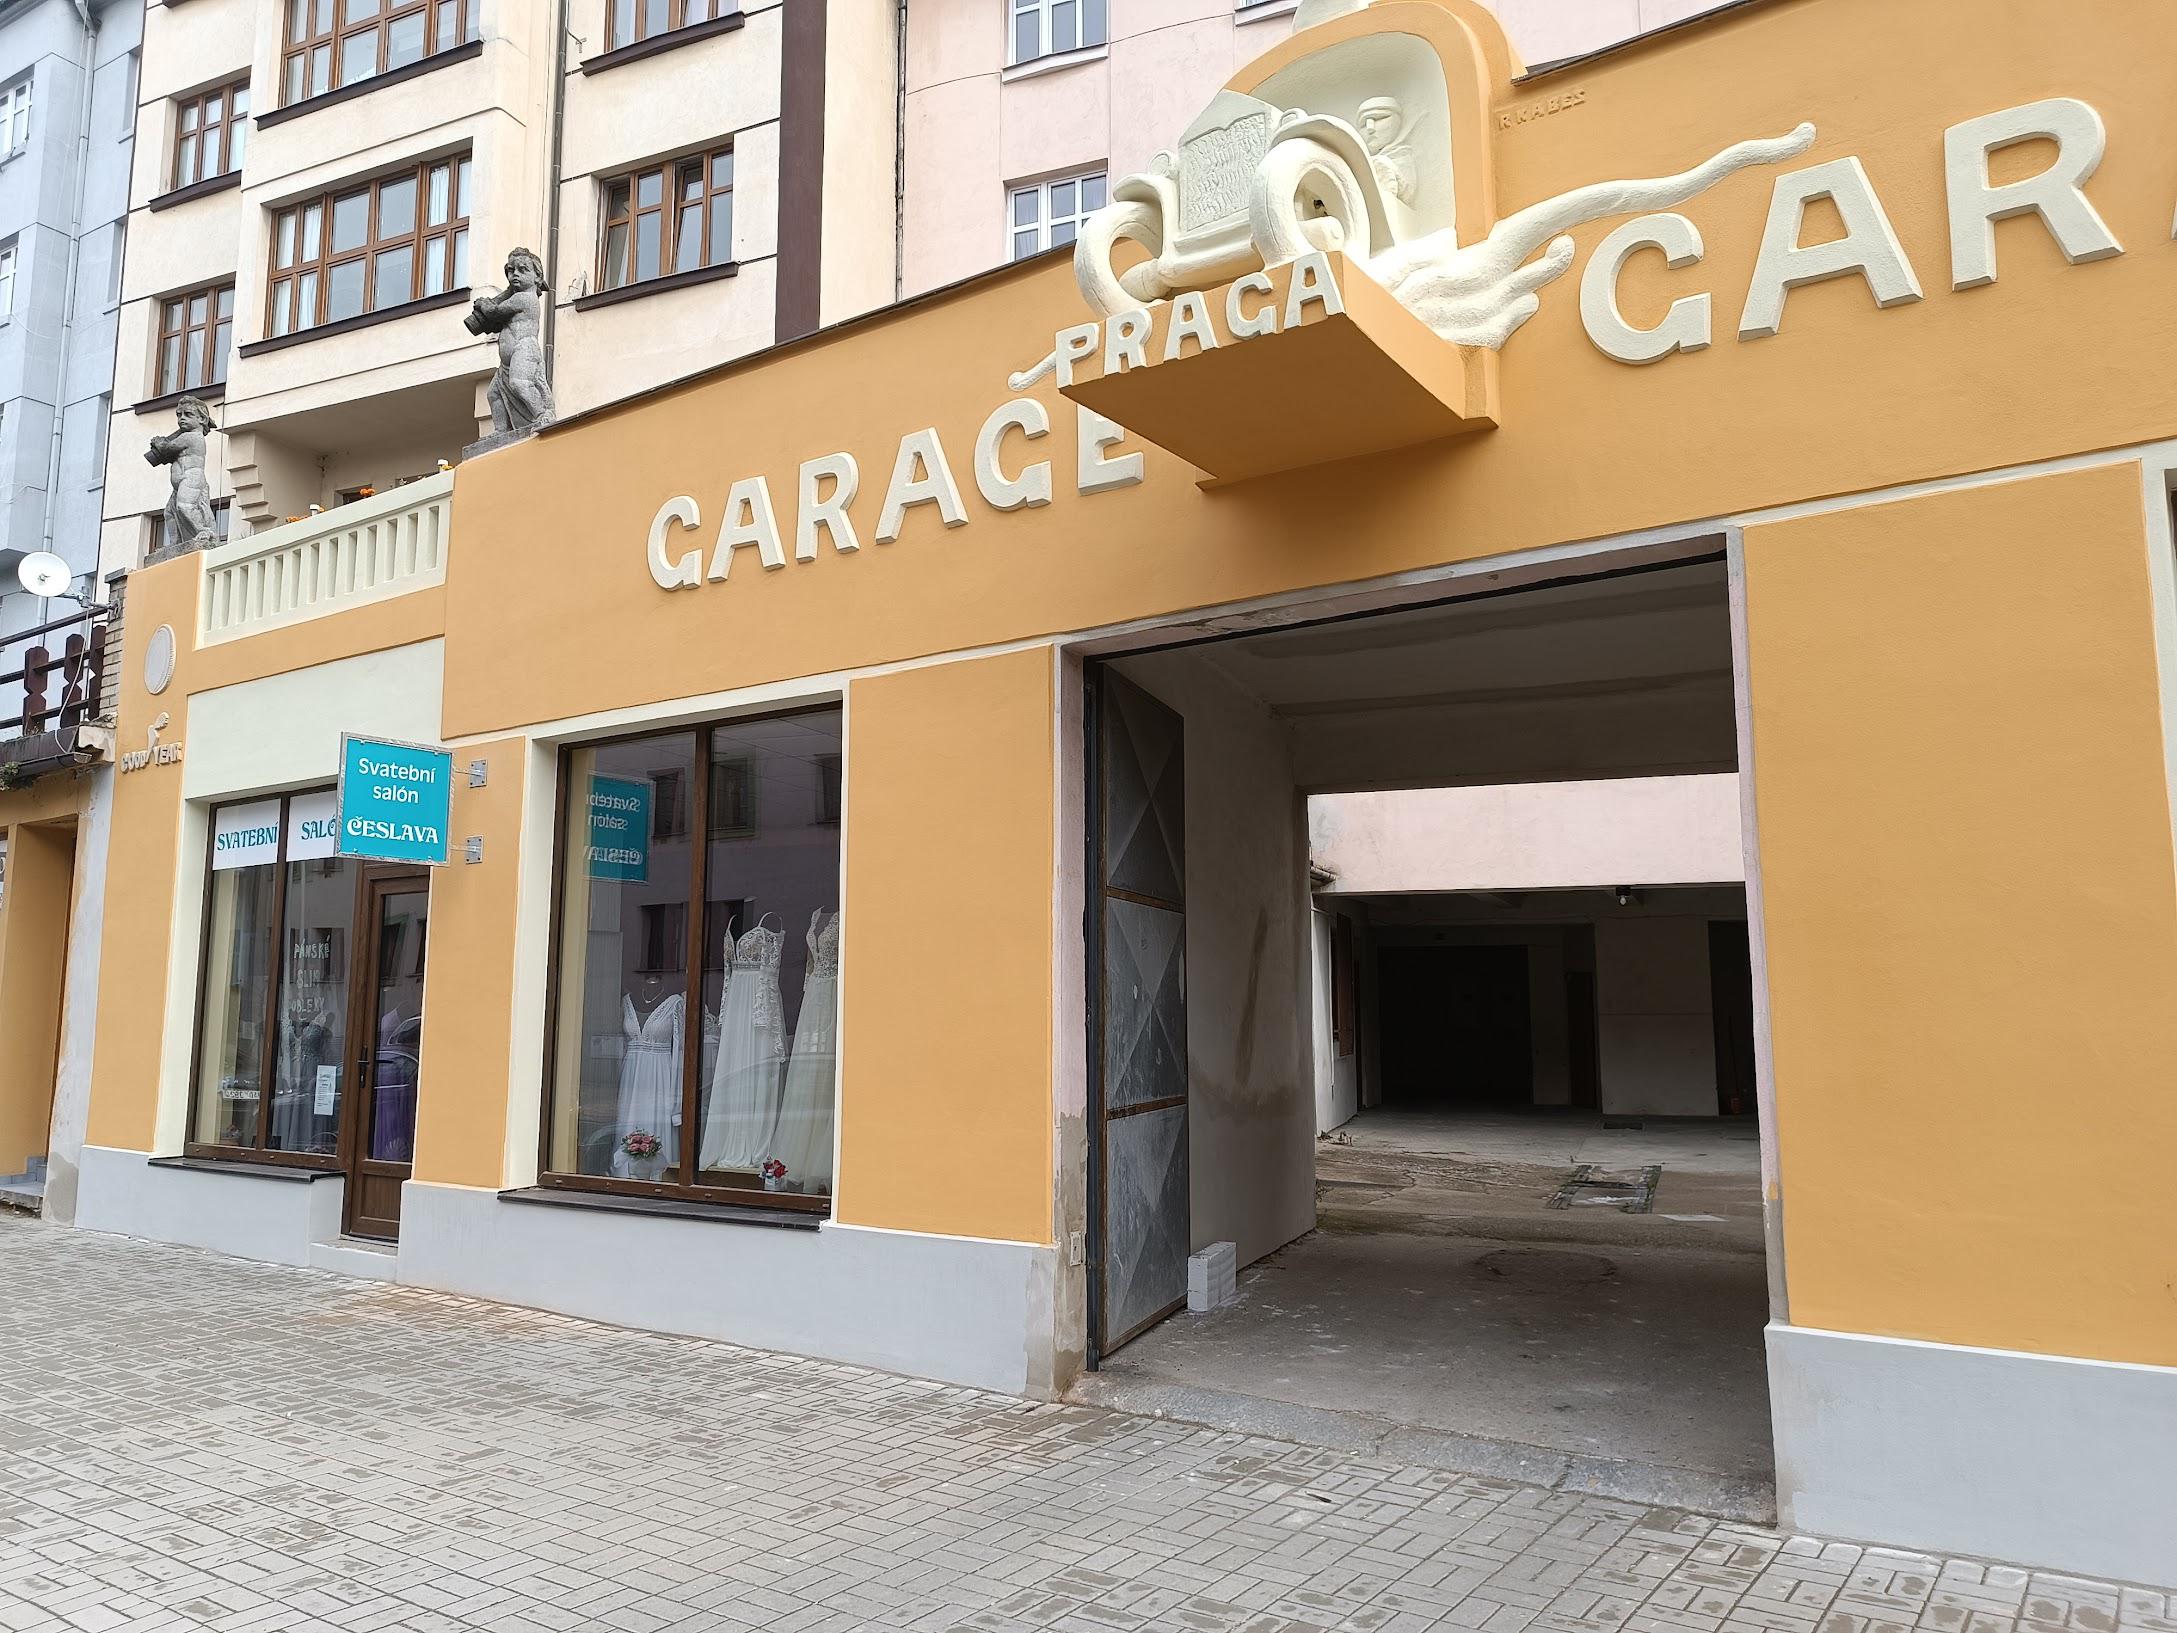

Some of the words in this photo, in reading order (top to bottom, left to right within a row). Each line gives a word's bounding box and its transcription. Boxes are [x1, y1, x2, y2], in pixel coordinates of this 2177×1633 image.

[1580, 96, 2177, 366] GAR
[1055, 251, 1345, 389] PRAGA
[647, 397, 1144, 592] GARAGE
[358, 757, 437, 784] Svatební
[373, 784, 419, 804] salón
[216, 821, 279, 851] SVATEBNÍ
[301, 813, 337, 841] SALÓ
[346, 815, 439, 844] ČESLAVA
